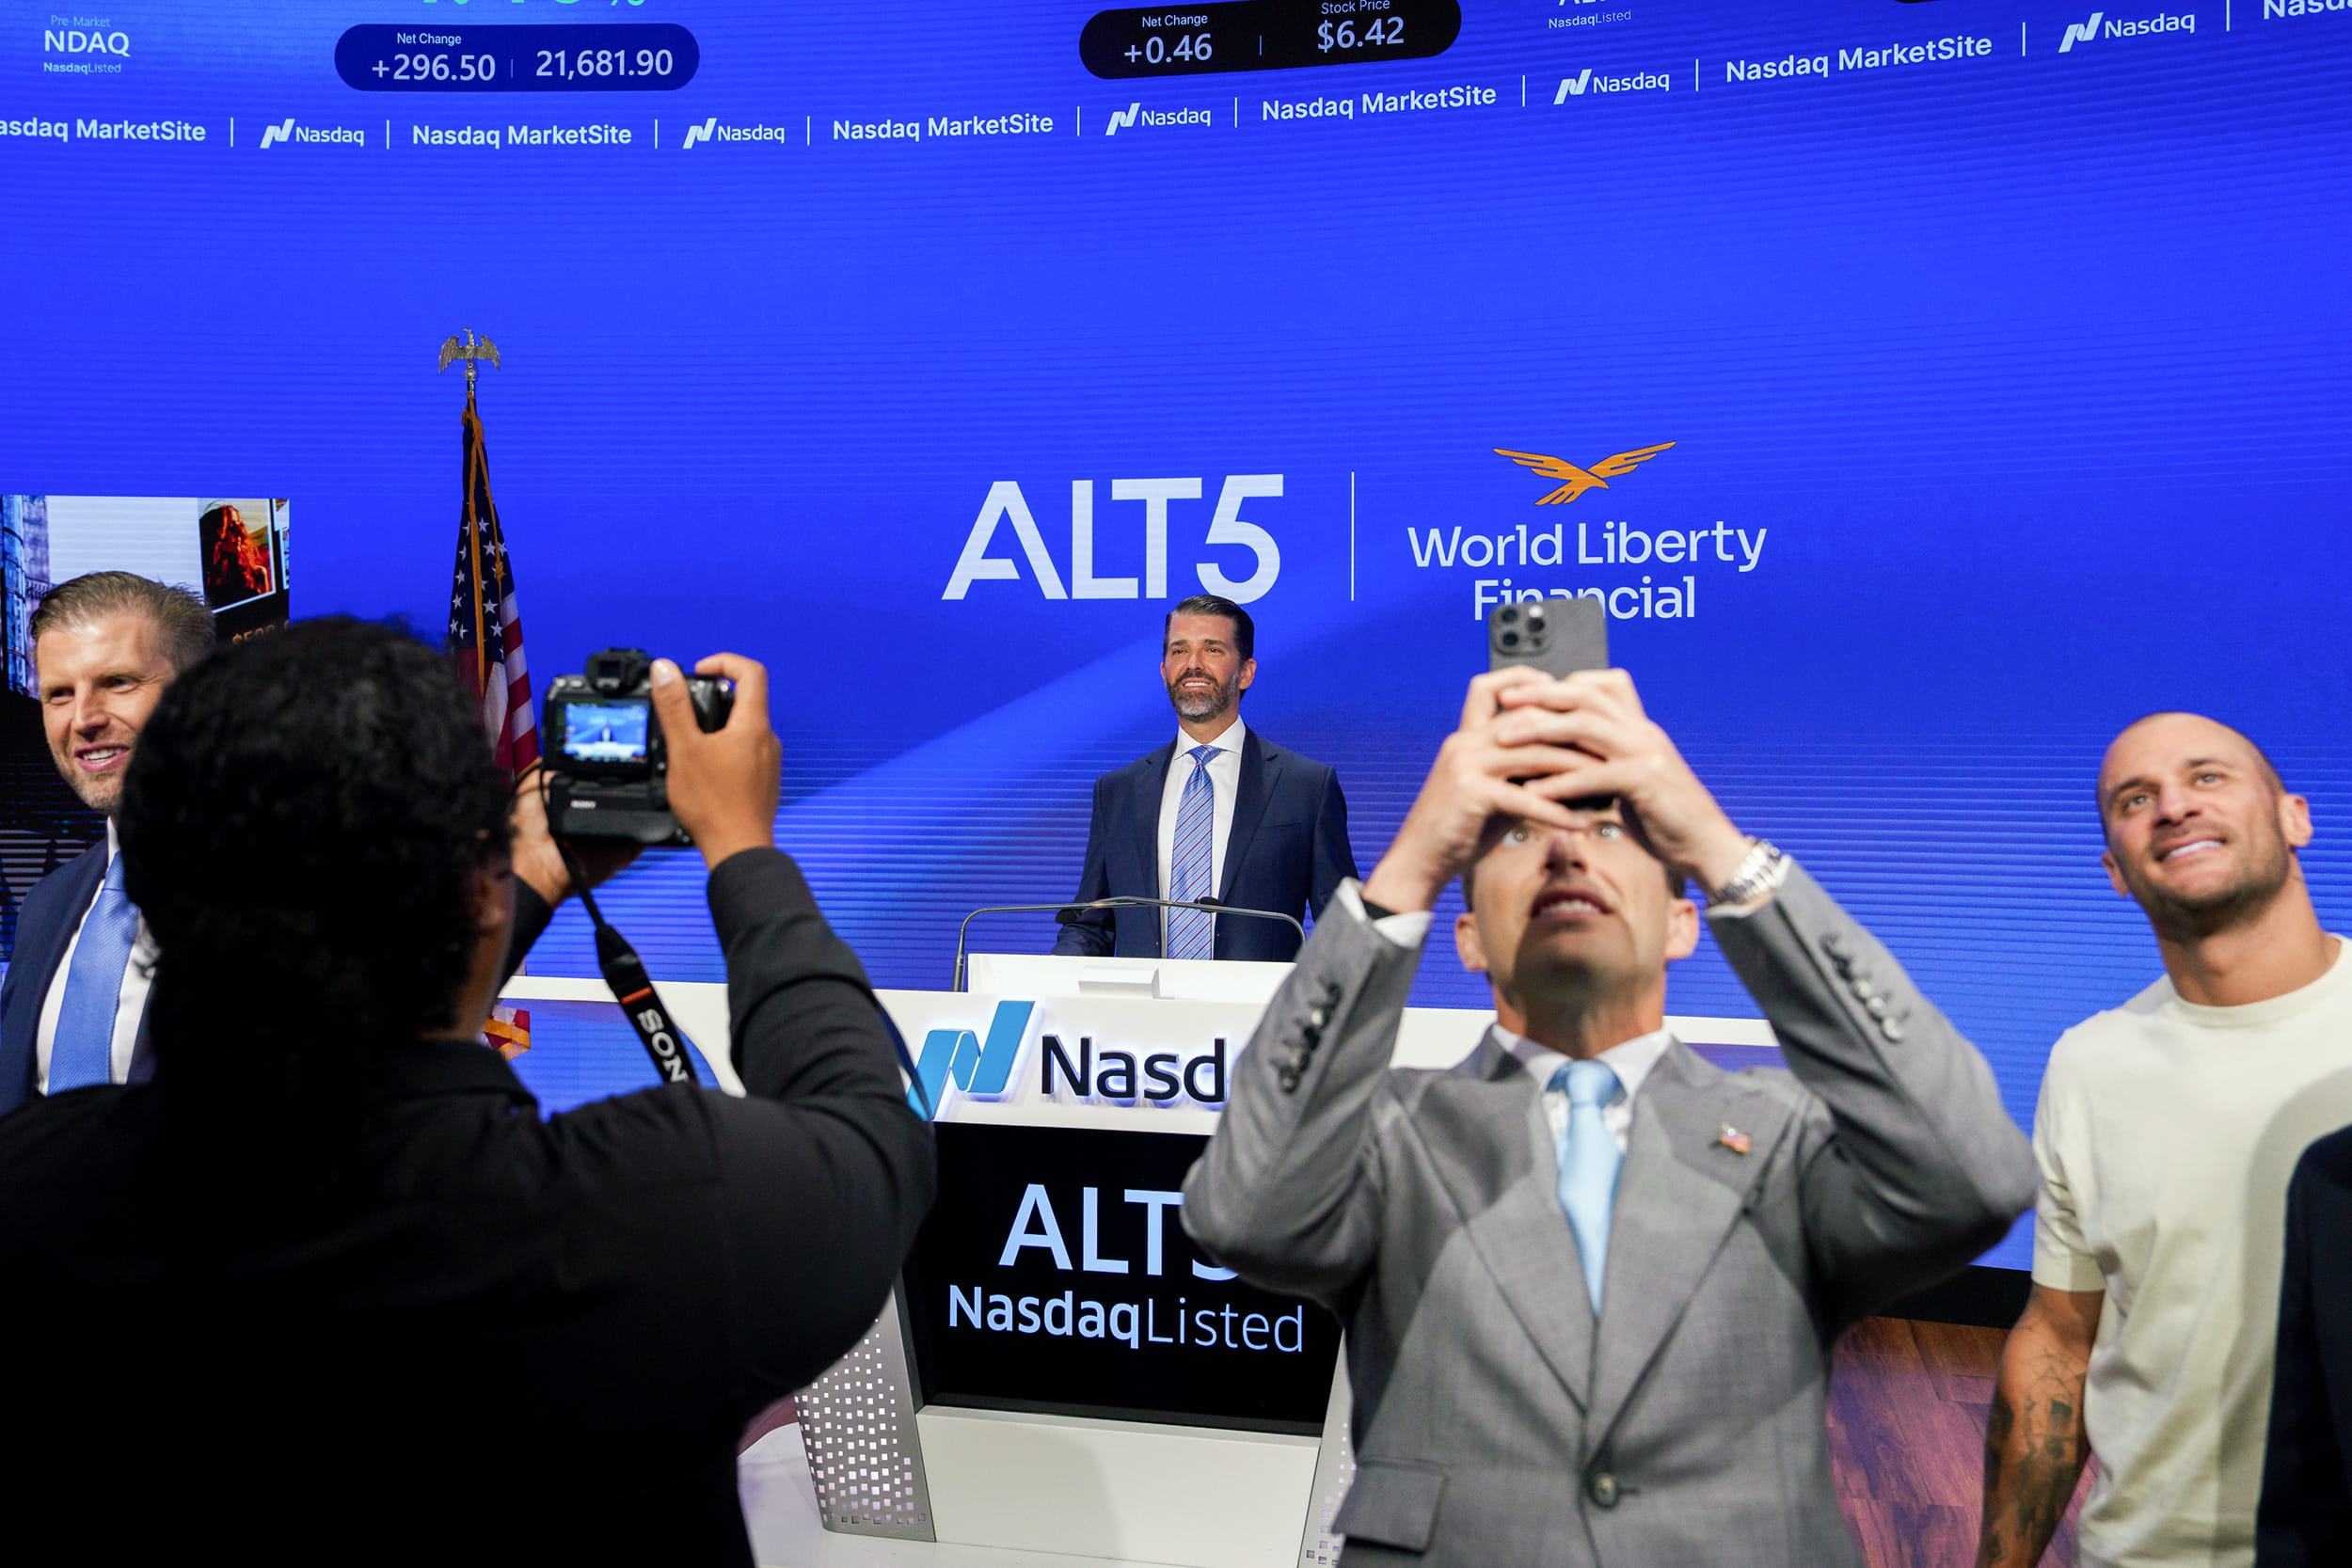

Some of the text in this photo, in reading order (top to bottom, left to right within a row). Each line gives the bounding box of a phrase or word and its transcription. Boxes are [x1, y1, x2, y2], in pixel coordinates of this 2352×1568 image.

[1142, 14, 1208, 27] Net Change
[1321, 0, 1391, 14] Stock Price
[1549, 10, 1631, 29] NasdaqListed
[51, 15, 111, 27] Pre-Market
[1317, 16, 1405, 53] $6.42
[2105, 12, 2195, 39] Nasdaq
[44, 30, 131, 57] NDAQ
[397, 33, 462, 47] Net Change
[1123, 33, 1213, 64] +0.46
[43, 62, 121, 75] NasdaqListed
[372, 54, 496, 81] +296.50
[535, 49, 674, 81] 21,681.90
[1726, 35, 1993, 83] Nasdaq MarketSite
[1593, 71, 1670, 93] Nasdaq
[1141, 106, 1212, 127] Nasdaq
[1263, 86, 1497, 121] Nasdaq MarketSite
[0, 117, 206, 142] asdaq MarketSite
[295, 126, 365, 147] Nasdaq
[413, 123, 632, 150] Nasdaq MarketSite
[718, 123, 786, 144] Nasdaq
[833, 112, 1054, 142] Nasdaq MarketSite
[941, 473, 1283, 604] ALT5
[1406, 520, 1768, 572] World Liberty
[636, 1008, 690, 1083] SON
[1041, 1034, 1227, 1102] Nasd
[998, 1183, 1239, 1281] ALT
[948, 1284, 1303, 1353] NasdaqListed
